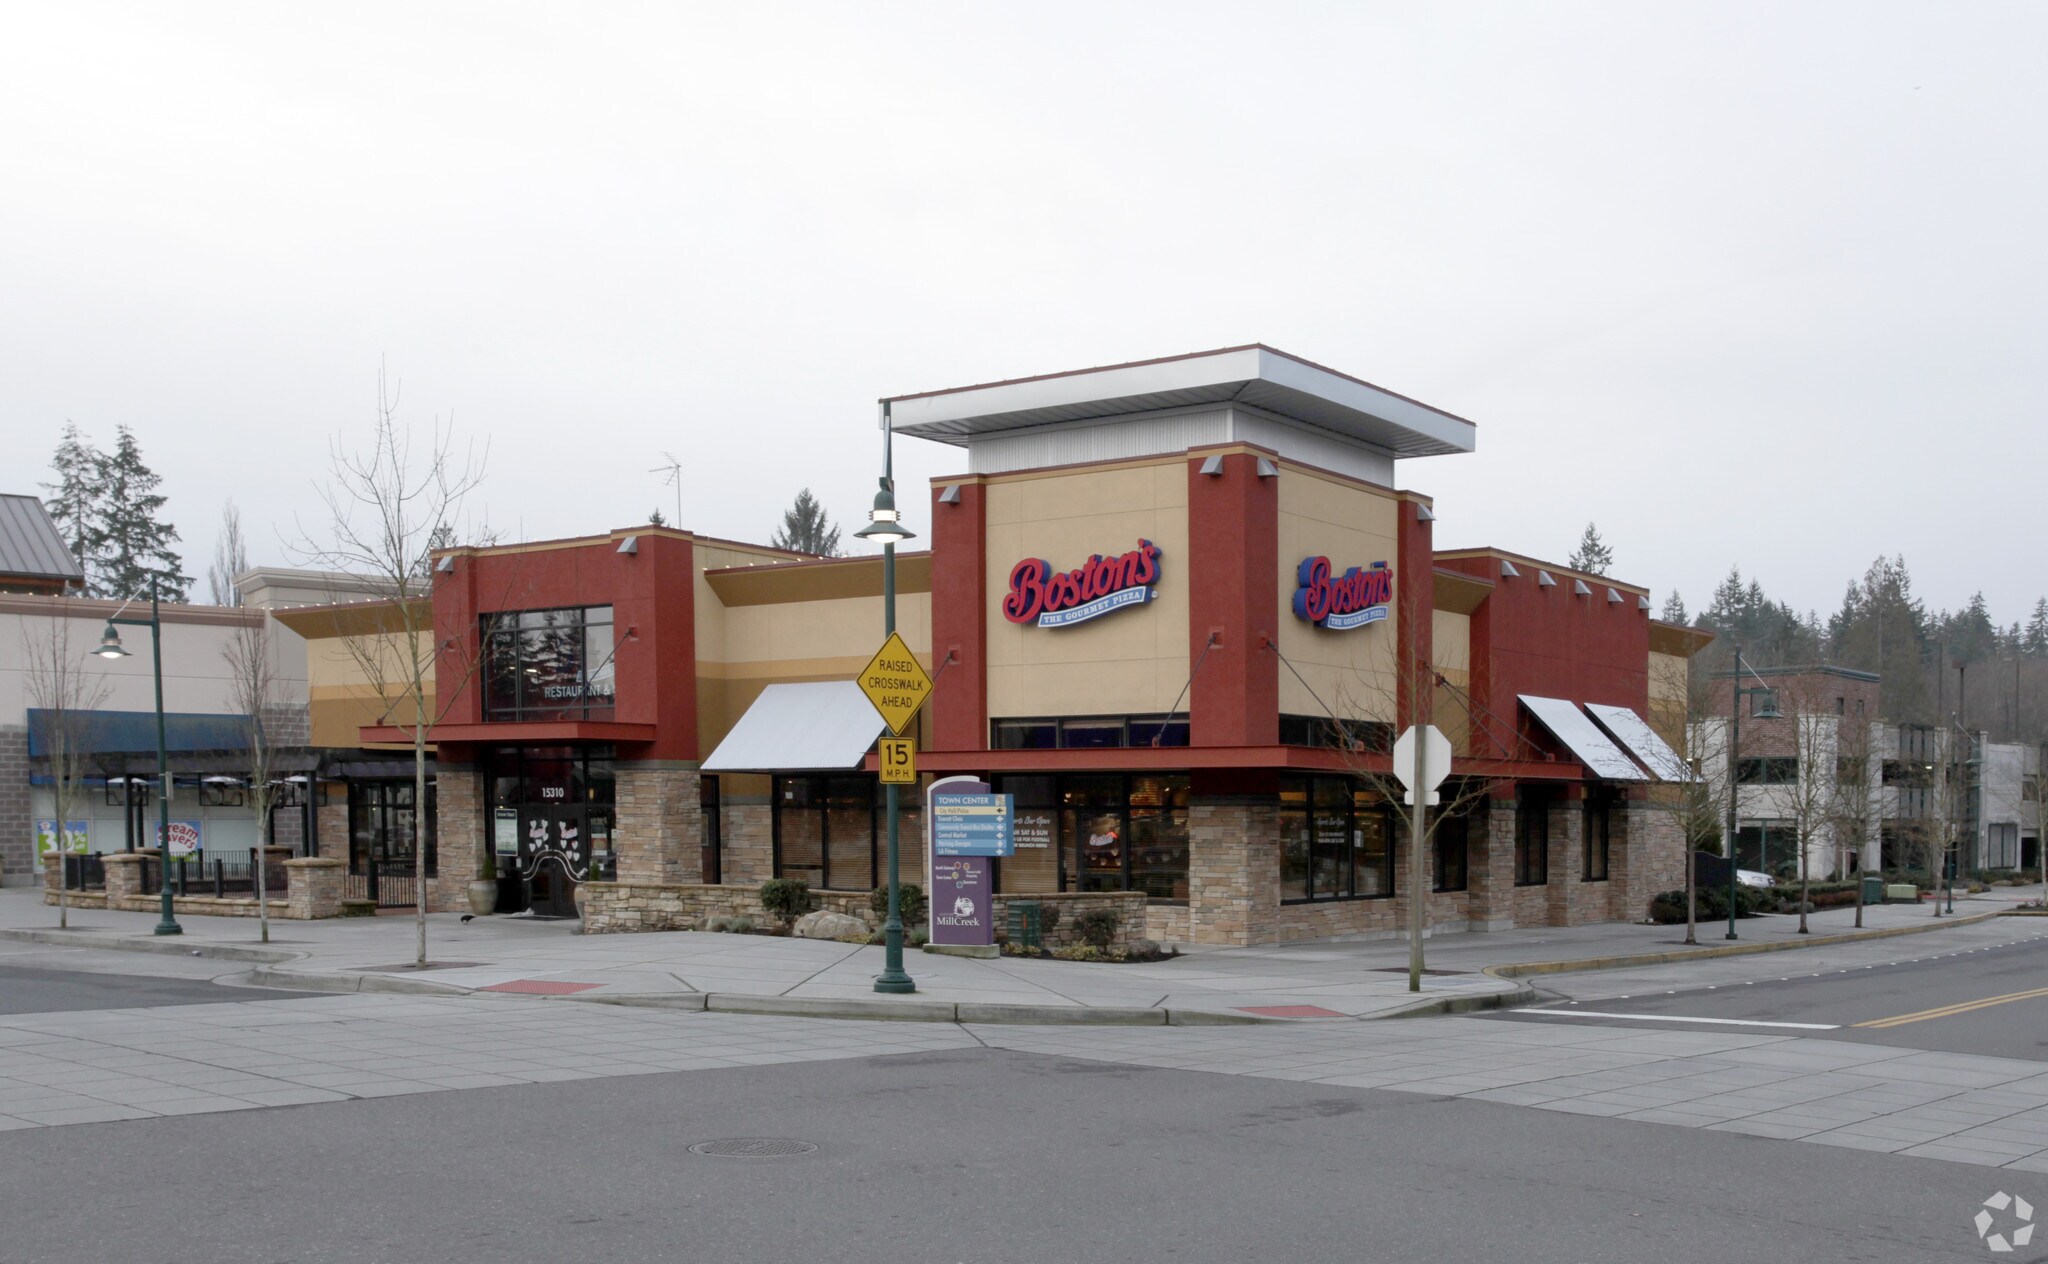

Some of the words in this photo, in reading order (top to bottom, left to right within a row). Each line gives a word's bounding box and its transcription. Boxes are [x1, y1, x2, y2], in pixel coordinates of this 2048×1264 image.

[1002, 538, 1160, 624] Boston's
[1301, 556, 1393, 621] Boston's
[1043, 615, 1063, 624] THE
[1065, 600, 1110, 621] GOURMET
[1112, 591, 1141, 605] PIZZA
[1331, 617, 1342, 626] THE
[1343, 612, 1369, 625] GOURMET
[1370, 609, 1385, 618] PIZZA
[880, 660, 912, 673] RAISED
[868, 677, 923, 691] CROSSWALK
[881, 696, 912, 708] AHEAD
[886, 744, 908, 765] 15
[542, 787, 564, 798] 15310
[938, 797, 960, 805] TOWN
[962, 797, 989, 805] CENTER
[158, 823, 199, 840] ream
